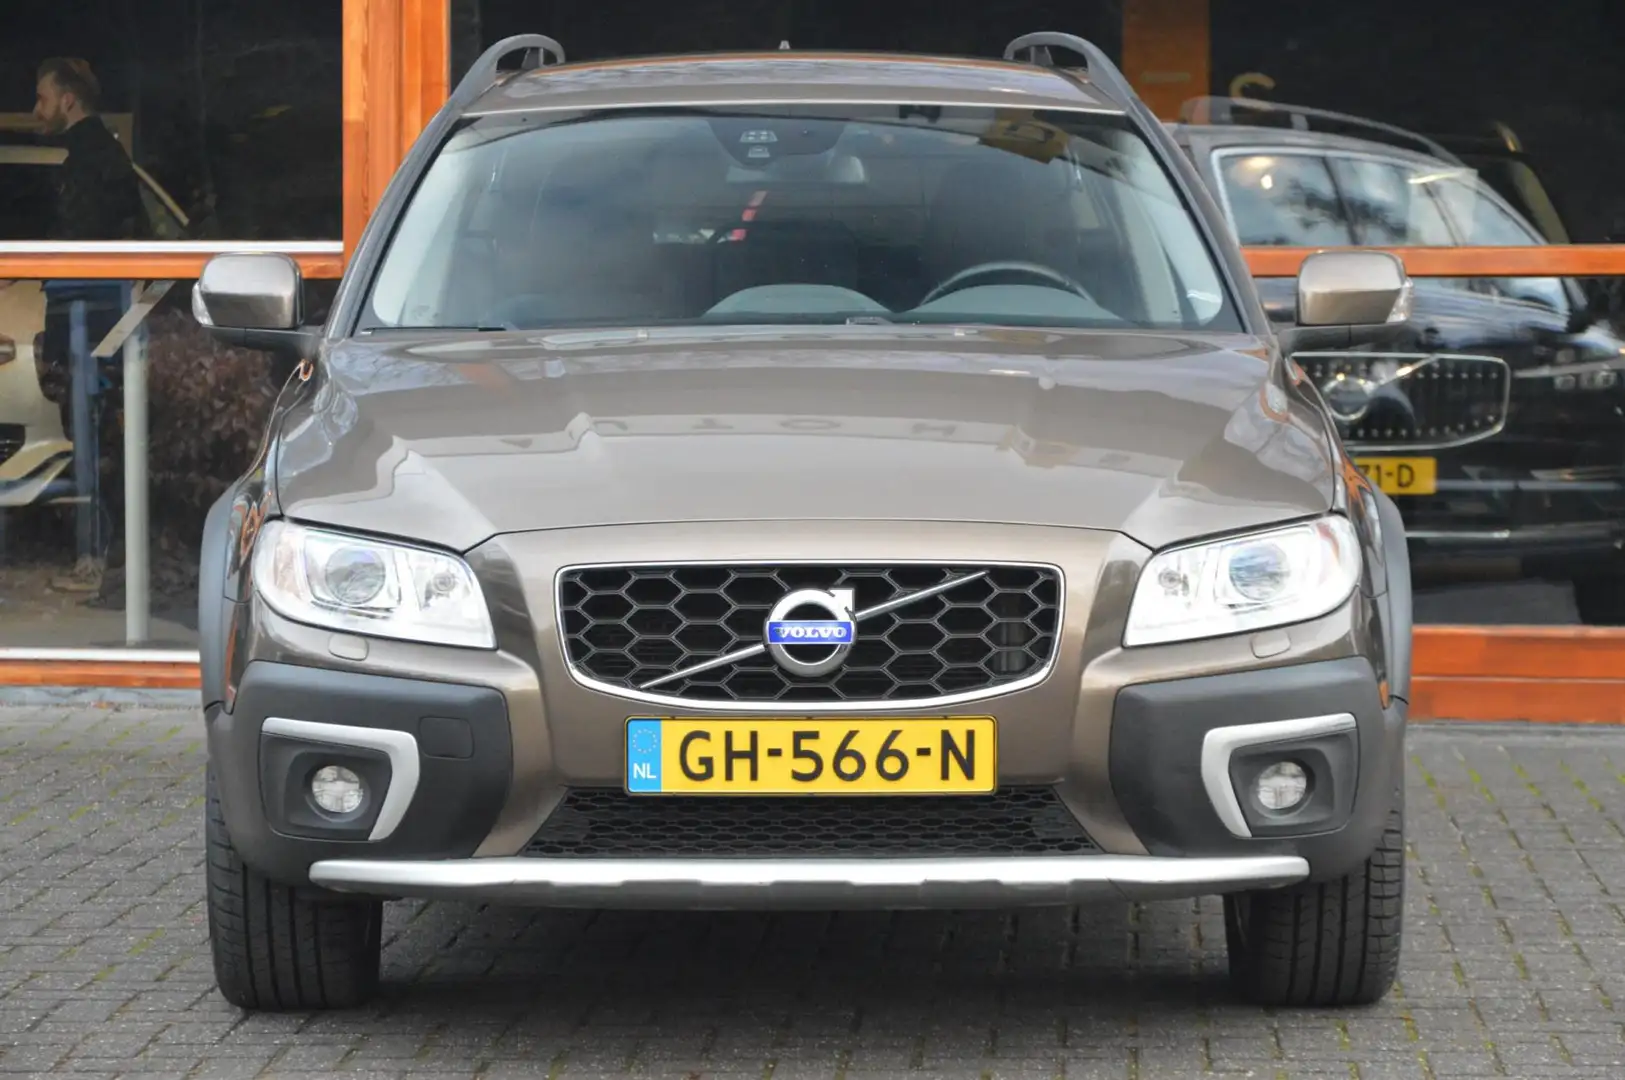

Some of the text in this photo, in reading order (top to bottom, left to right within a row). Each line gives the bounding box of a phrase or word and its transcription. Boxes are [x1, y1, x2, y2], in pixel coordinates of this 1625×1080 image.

[773, 626, 847, 639] VOLVO
[678, 729, 976, 782] GH-566-N
[632, 762, 657, 779] NL
